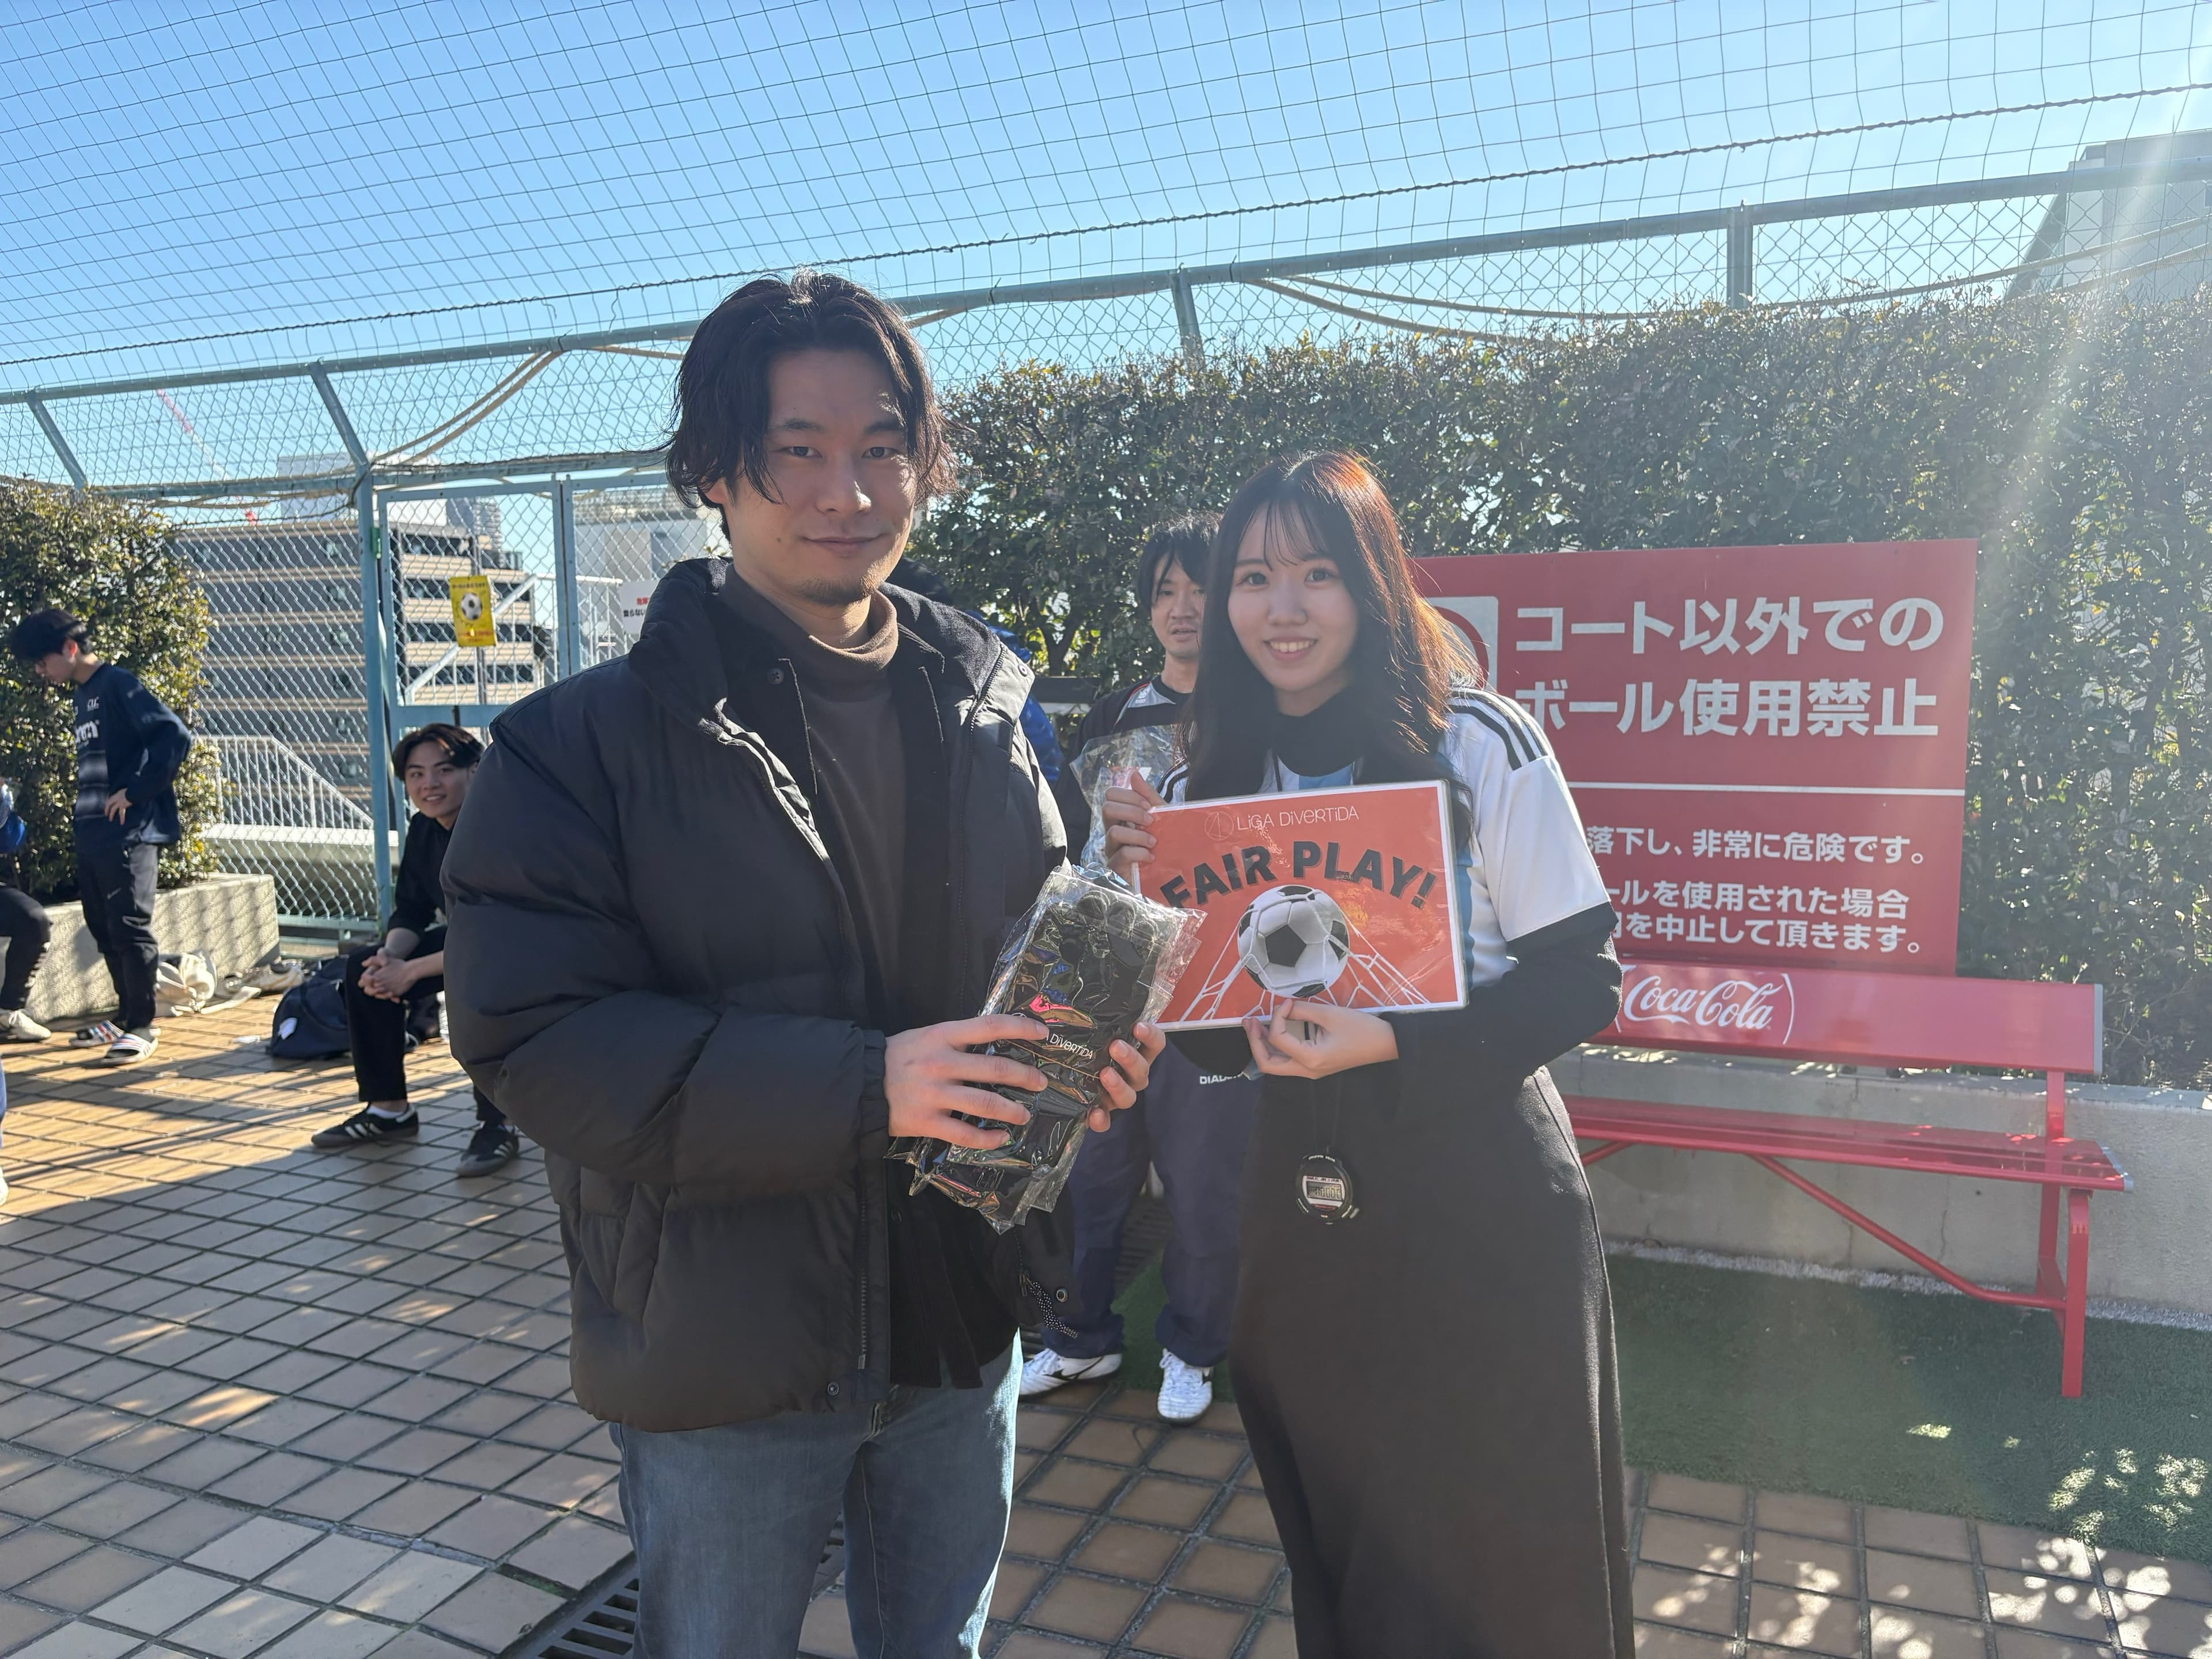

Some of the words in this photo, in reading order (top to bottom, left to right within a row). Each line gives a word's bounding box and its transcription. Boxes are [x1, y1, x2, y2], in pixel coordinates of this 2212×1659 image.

[1516, 596, 1944, 656] コート以外での
[1515, 677, 1938, 737] ボール使用禁止
[1586, 825, 1923, 864] 落下し、非常に危険です。
[1160, 845, 1278, 908] FAIR
[1293, 840, 1437, 910] PLAY!
[1623, 975, 1784, 1030] Coca-Cola
